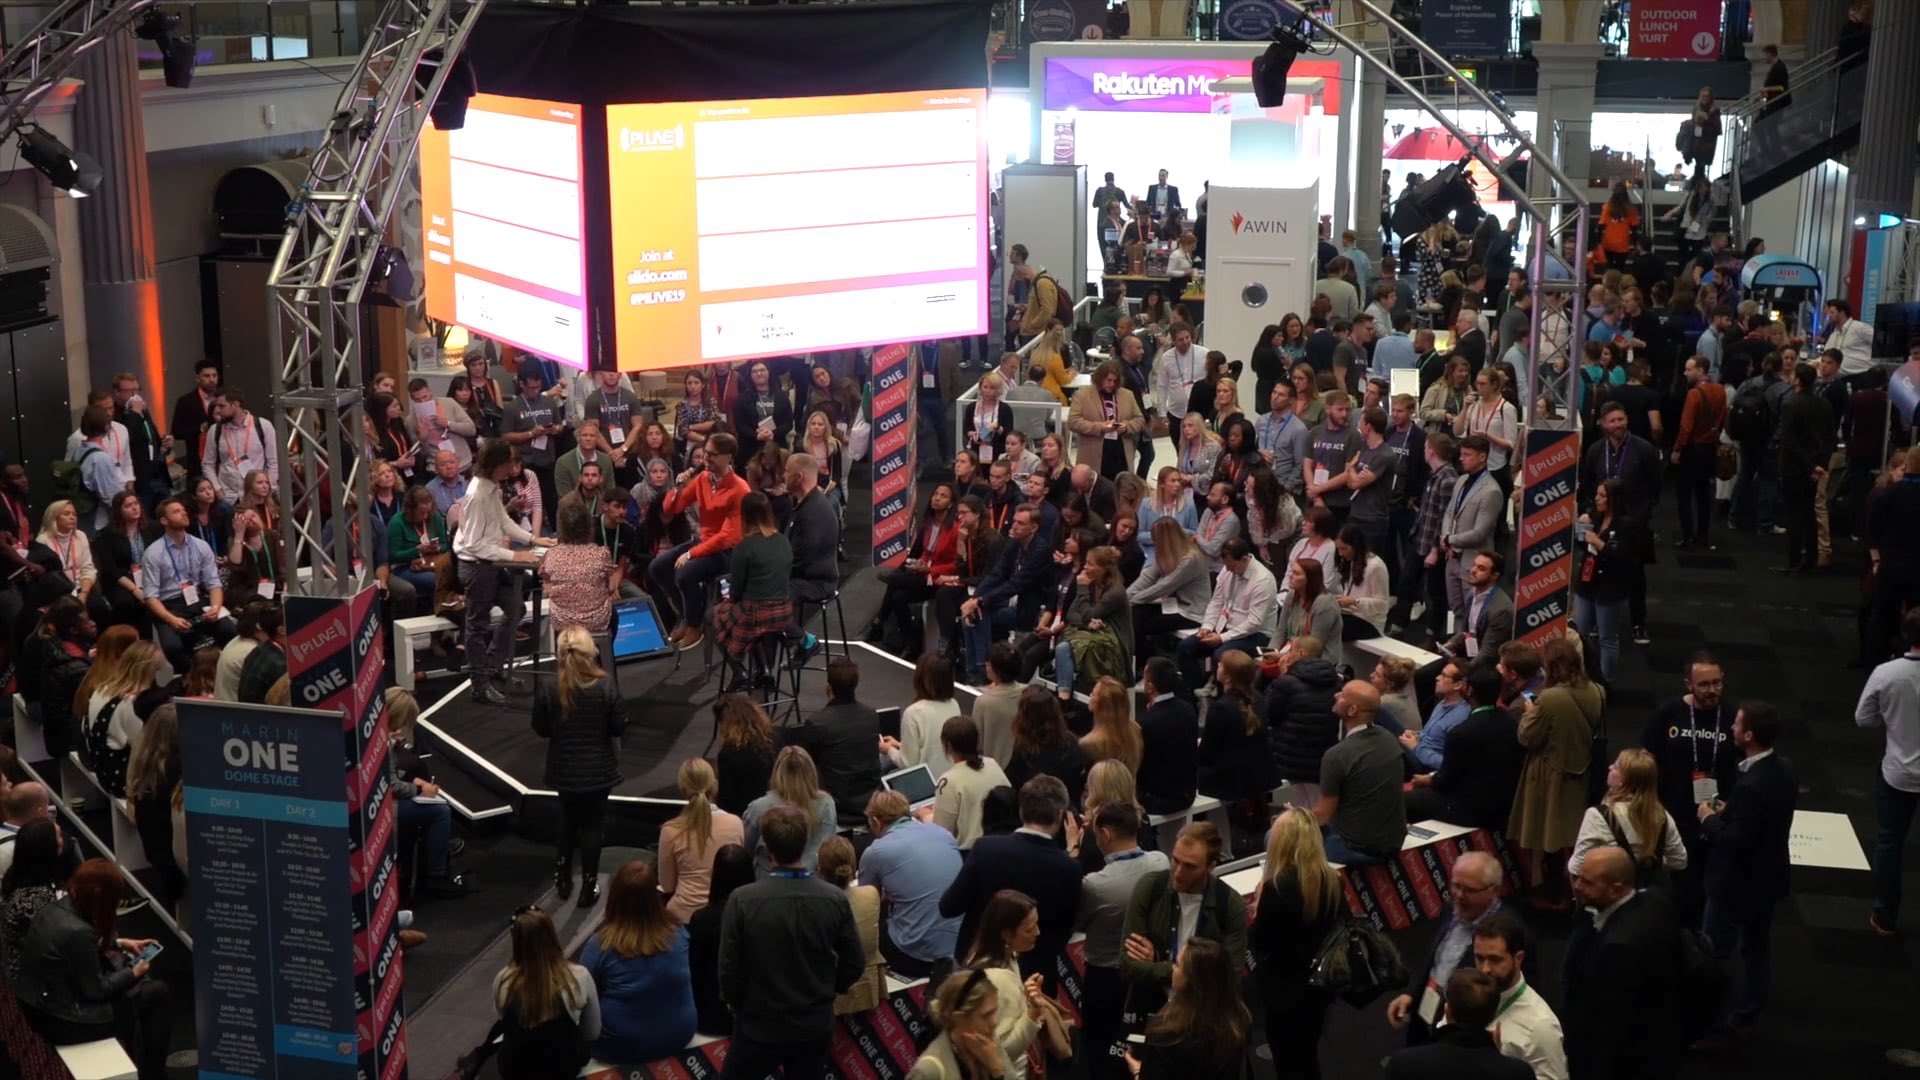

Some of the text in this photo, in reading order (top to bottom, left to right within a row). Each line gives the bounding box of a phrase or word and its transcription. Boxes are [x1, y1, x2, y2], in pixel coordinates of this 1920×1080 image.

[1641, 10, 1697, 20] OUTDOOR
[1640, 22, 1678, 32] LUNCH
[1639, 33, 1669, 43] YURT
[1093, 72, 1185, 95] Rakuten
[1243, 220, 1287, 233] AWIN
[640, 249, 674, 263] Join at
[627, 268, 688, 285] slido.com
[880, 369, 904, 388] ONE
[880, 412, 904, 431] ONE
[880, 456, 903, 475] ONE
[1547, 450, 1568, 467] LIVE
[1534, 480, 1570, 507] ONE
[880, 499, 903, 518] ONE
[1543, 511, 1565, 528] LIVE
[880, 541, 903, 559] ONE
[1530, 541, 1566, 567] ONE
[1539, 572, 1560, 589] LIVE
[1526, 601, 1562, 627] ONE
[300, 626, 338, 656] PI LIVE
[359, 613, 379, 656] ONE
[303, 668, 347, 702] ONE
[363, 694, 384, 739] ONE
[222, 721, 298, 741] MARIN
[1681, 728, 1727, 743] zenloop
[223, 737, 299, 773] ONE
[224, 769, 300, 788] DOME STAGE
[210, 797, 232, 809] DAY
[368, 775, 389, 820] ONE
[286, 804, 305, 816] DAY
[373, 854, 393, 900] ONE
[378, 932, 398, 978] ONE
[1065, 977, 1082, 999] ONE
[894, 998, 913, 1021] ONE
[382, 1009, 403, 1056] ONE
[859, 1036, 878, 1059] ONE
[686, 1055, 707, 1080] ONE
